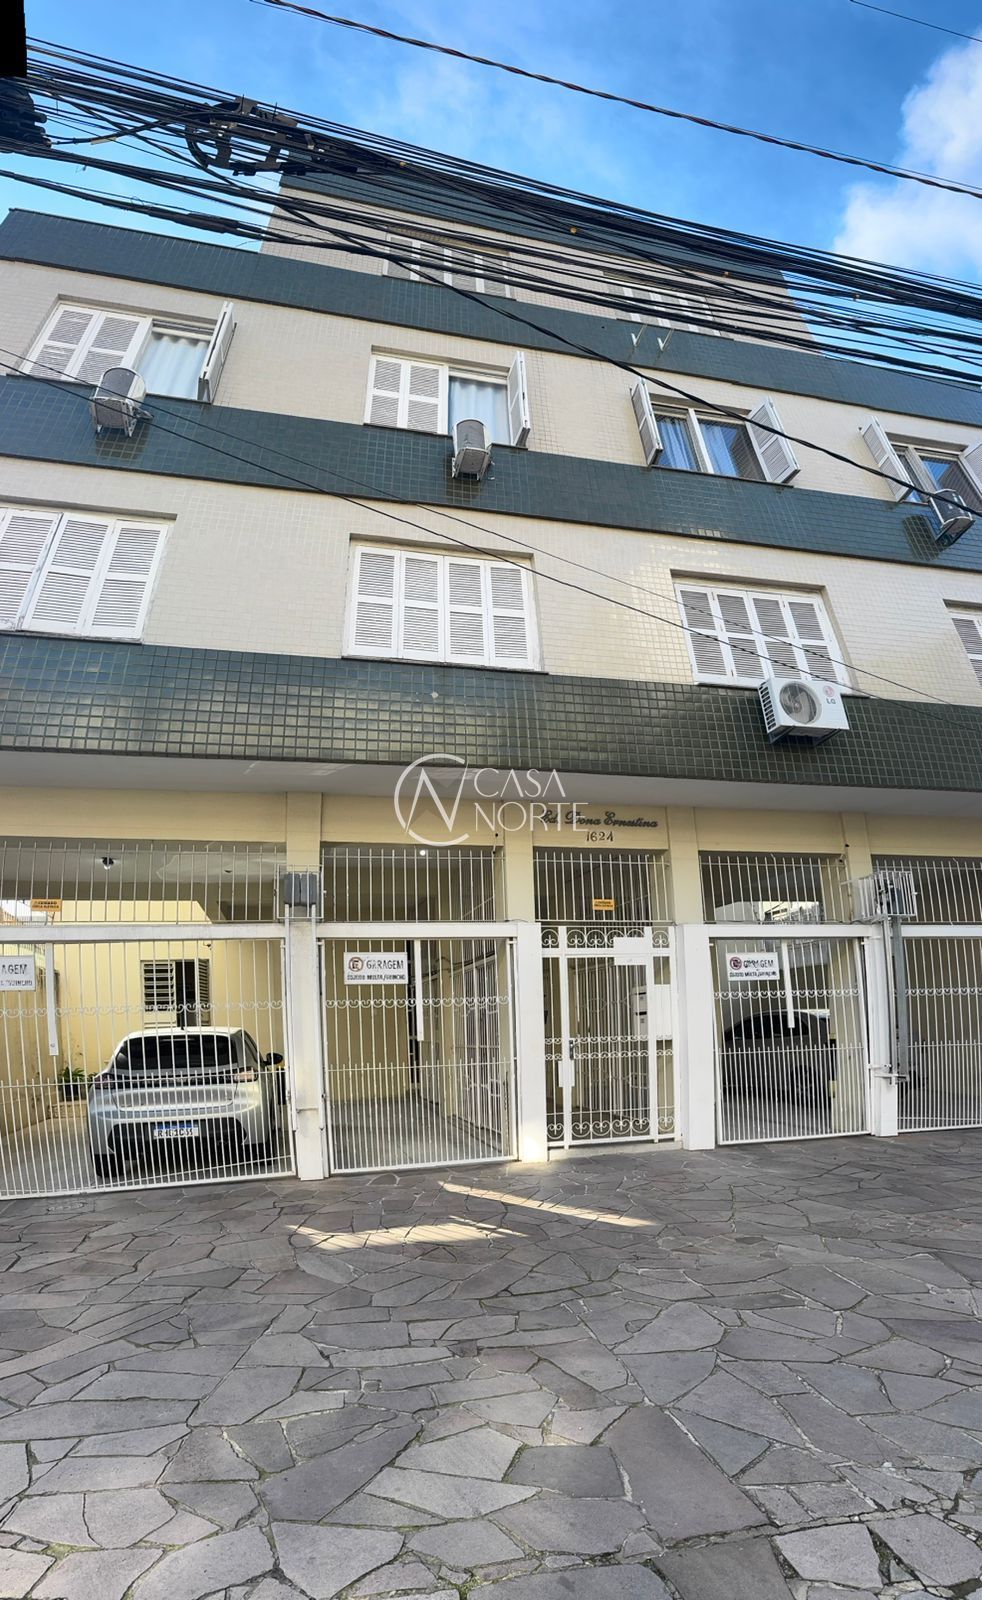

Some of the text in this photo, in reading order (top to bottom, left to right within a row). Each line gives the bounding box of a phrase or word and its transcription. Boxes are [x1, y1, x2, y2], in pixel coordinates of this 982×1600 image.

[565, 811, 601, 825] Dona
[586, 831, 614, 842] 1624
[366, 960, 404, 969] GARAGEM
